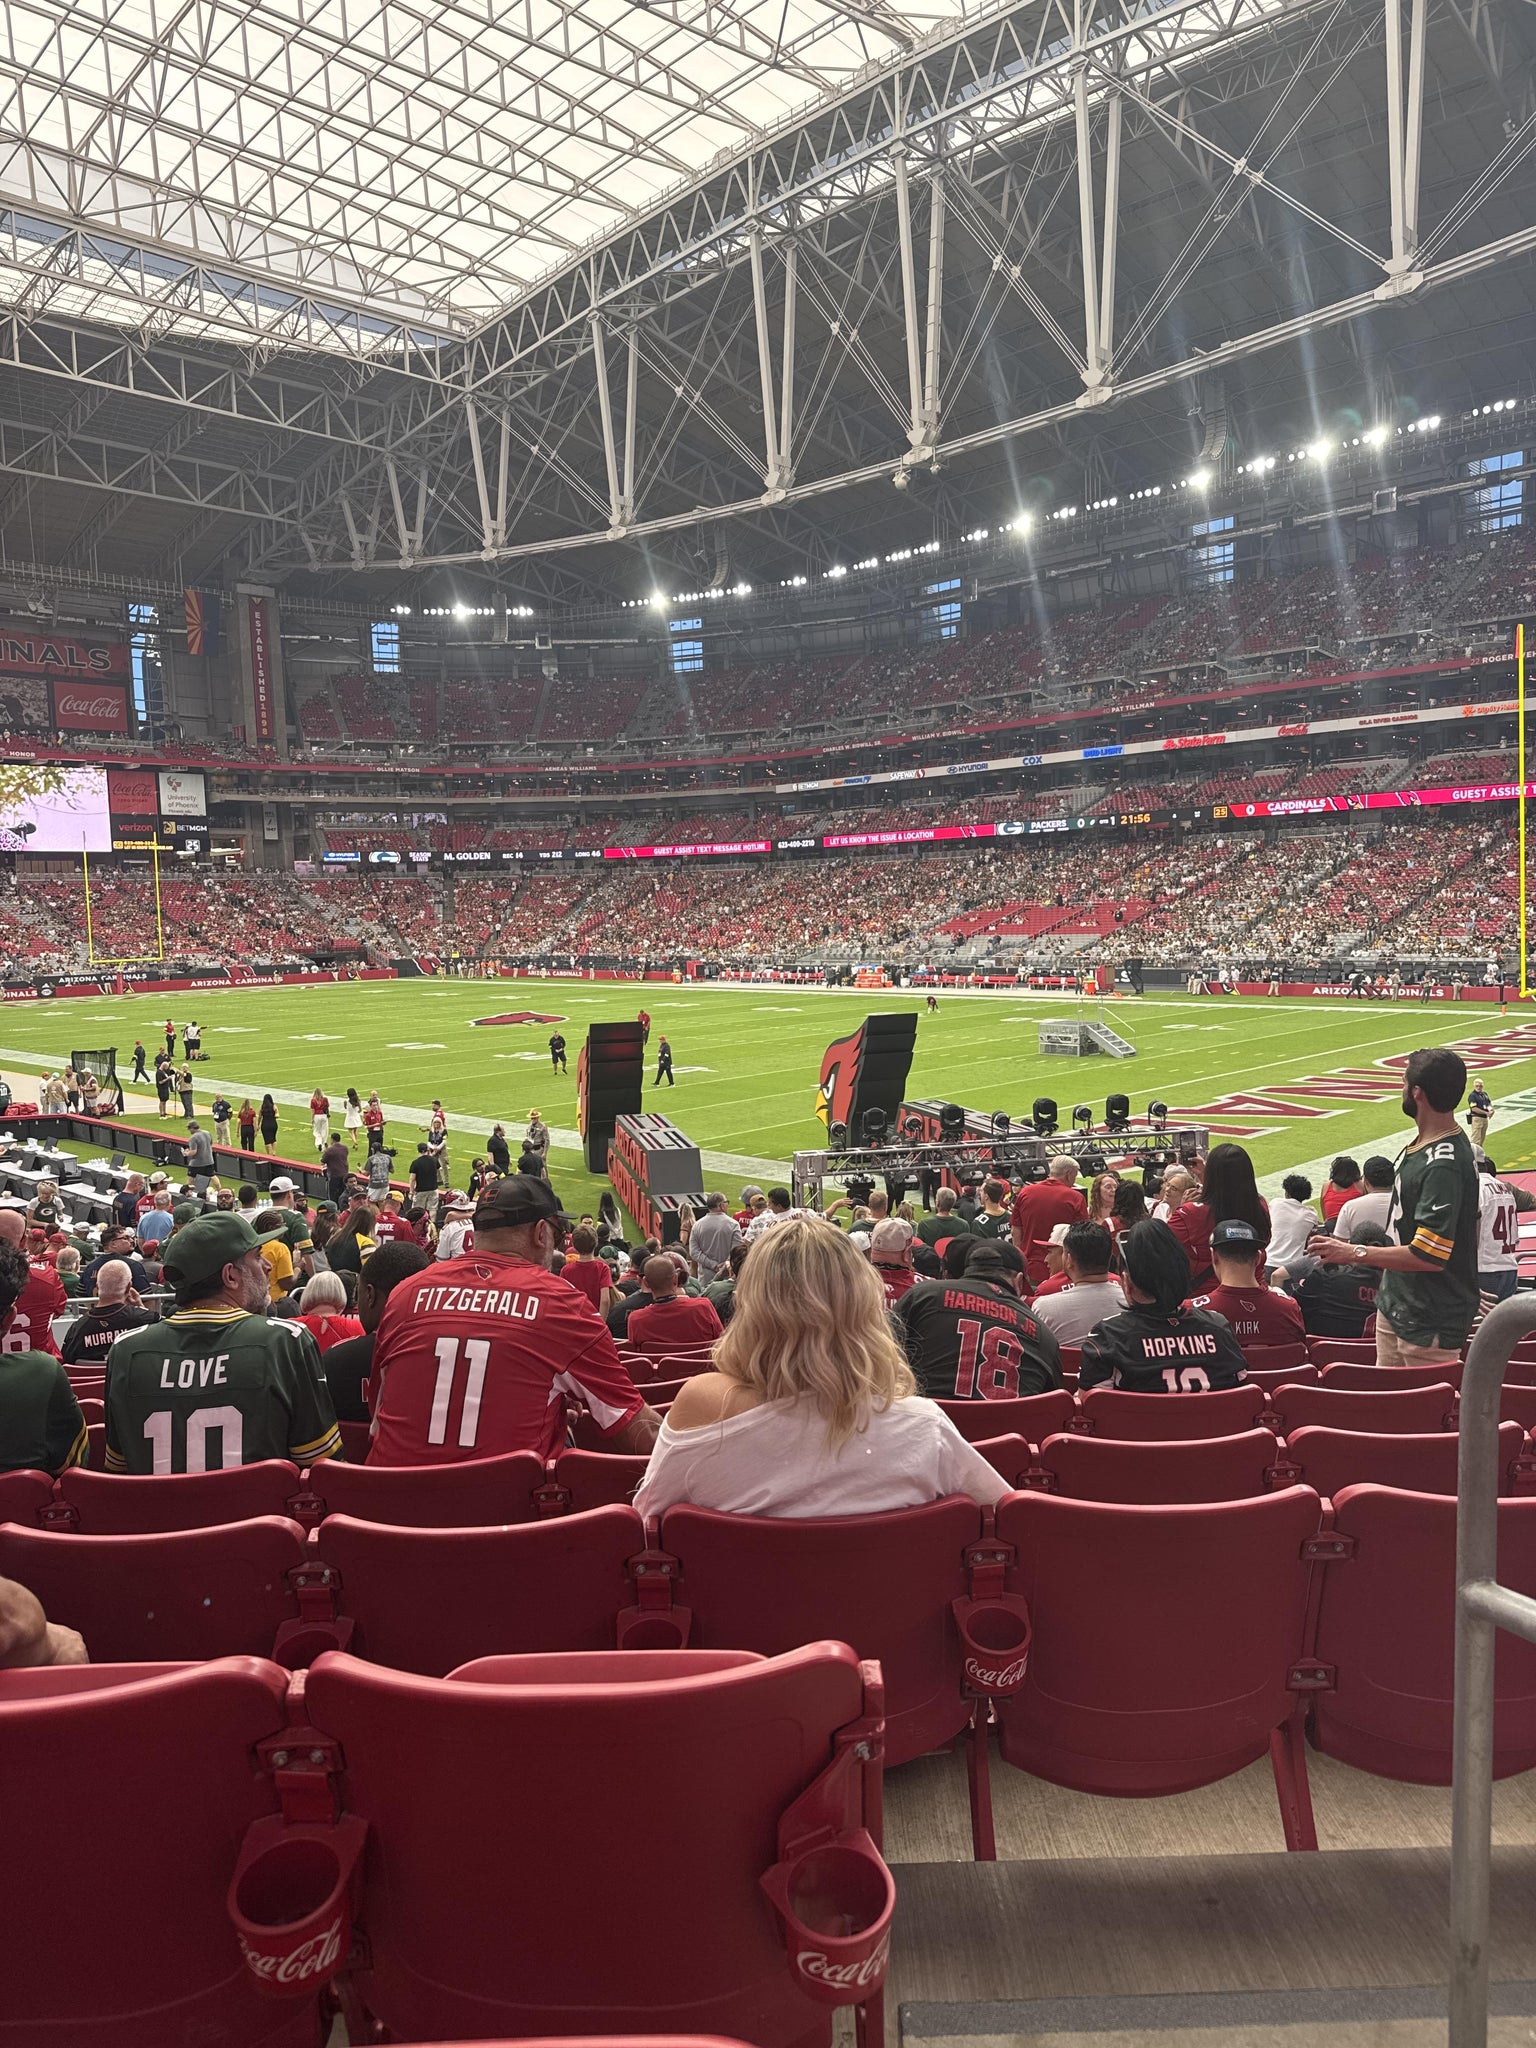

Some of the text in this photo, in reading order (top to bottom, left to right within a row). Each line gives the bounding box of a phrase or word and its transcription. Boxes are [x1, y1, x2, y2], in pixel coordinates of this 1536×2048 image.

[0, 638, 111, 671] NALS
[255, 612, 266, 702] ESTABLISHED
[1482, 653, 1514, 664] ROGER
[60, 695, 122, 718] Coca-Cola
[1111, 705, 1124, 713] PAT
[1125, 702, 1155, 711] TILLMAN
[912, 733, 934, 741] WILLIAM
[1177, 734, 1226, 749] State Farm
[10, 750, 36, 758] HONOR
[823, 744, 845, 753] CHARLES
[1022, 755, 1043, 767] COX
[958, 763, 989, 772] HYUNDAI
[889, 771, 916, 781] SAFEWAY
[112, 783, 153, 797] Coca-Cola
[1452, 788, 1486, 800] GUEST
[168, 794, 197, 802] University
[1215, 799, 1327, 817] 25 0 CARDINALS
[1030, 819, 1067, 830] PACKERS
[1076, 818, 1085, 828] 0
[1110, 816, 1115, 826] 1
[1120, 813, 1151, 825] 21:56
[119, 823, 154, 832] verizon
[176, 824, 208, 832] BETMGM
[777, 839, 815, 849] 623-400-2210
[829, 837, 840, 845] LET
[840, 836, 848, 844] US
[849, 835, 867, 843] KNOW
[868, 834, 879, 842] THE
[879, 833, 897, 841] ISSUE
[903, 831, 934, 840] LOCATION
[186, 840, 199, 851] 25
[653, 843, 766, 855] GUEST ASSIST TEXT MESSAGE HOTLINE
[456, 852, 491, 861] GOLDEN
[101, 973, 147, 981] CARINALS
[190, 976, 283, 987] ARIZONA CARDINAS
[614, 1120, 650, 1188] ARIZONA
[1425, 1142, 1455, 1166] 12
[413, 1286, 540, 1321] FITZGERALD
[943, 1289, 1037, 1338] HARRISON JR
[1235, 1320, 1260, 1335] KIRK
[1141, 1334, 1217, 1358] HOPKINS
[954, 1318, 1025, 1400] 18
[160, 1354, 230, 1388] LOVE
[426, 1336, 492, 1448] 11
[143, 1405, 244, 1475] 10
